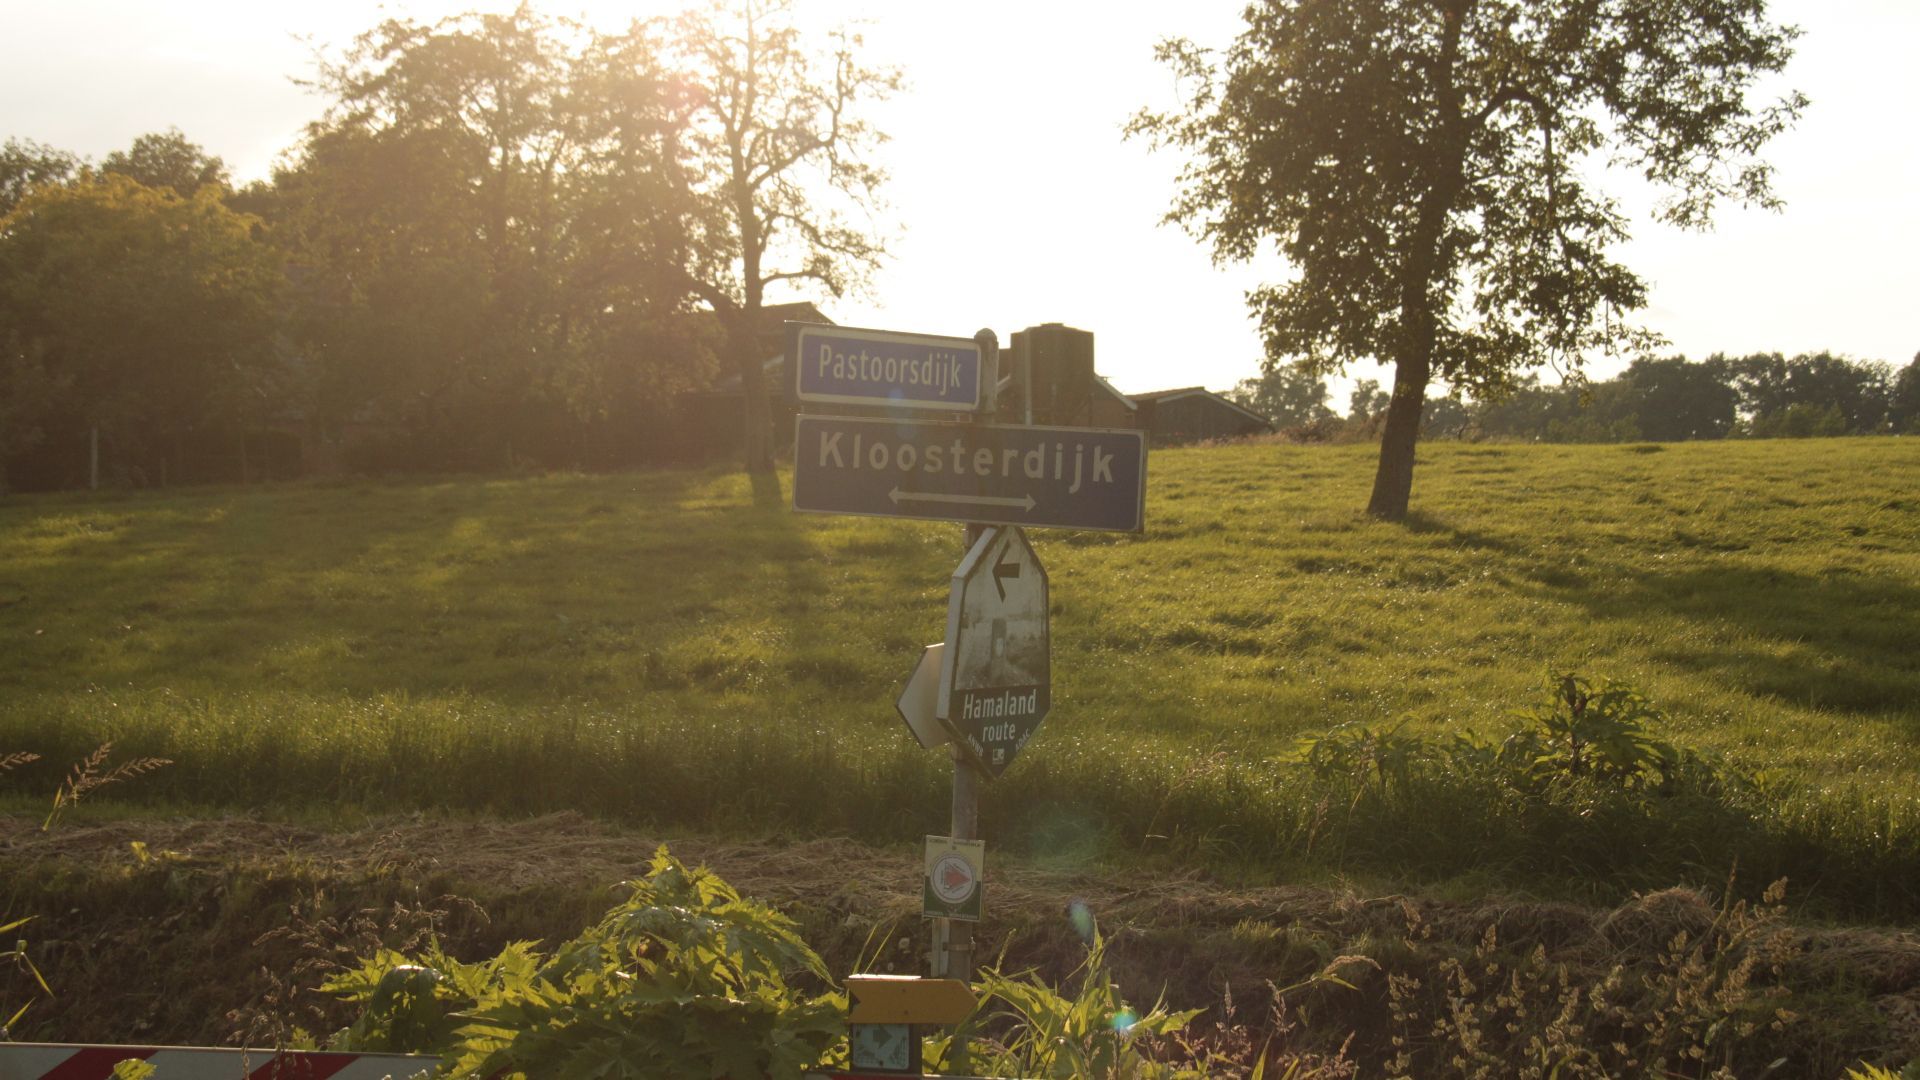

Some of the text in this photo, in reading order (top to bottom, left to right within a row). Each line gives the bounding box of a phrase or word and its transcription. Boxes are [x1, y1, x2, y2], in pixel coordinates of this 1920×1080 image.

[819, 344, 961, 396] Pastoorsdijk
[818, 431, 1115, 495] Kloosterdijk
[962, 688, 1037, 720] Hamaland
[982, 721, 1016, 743] route
